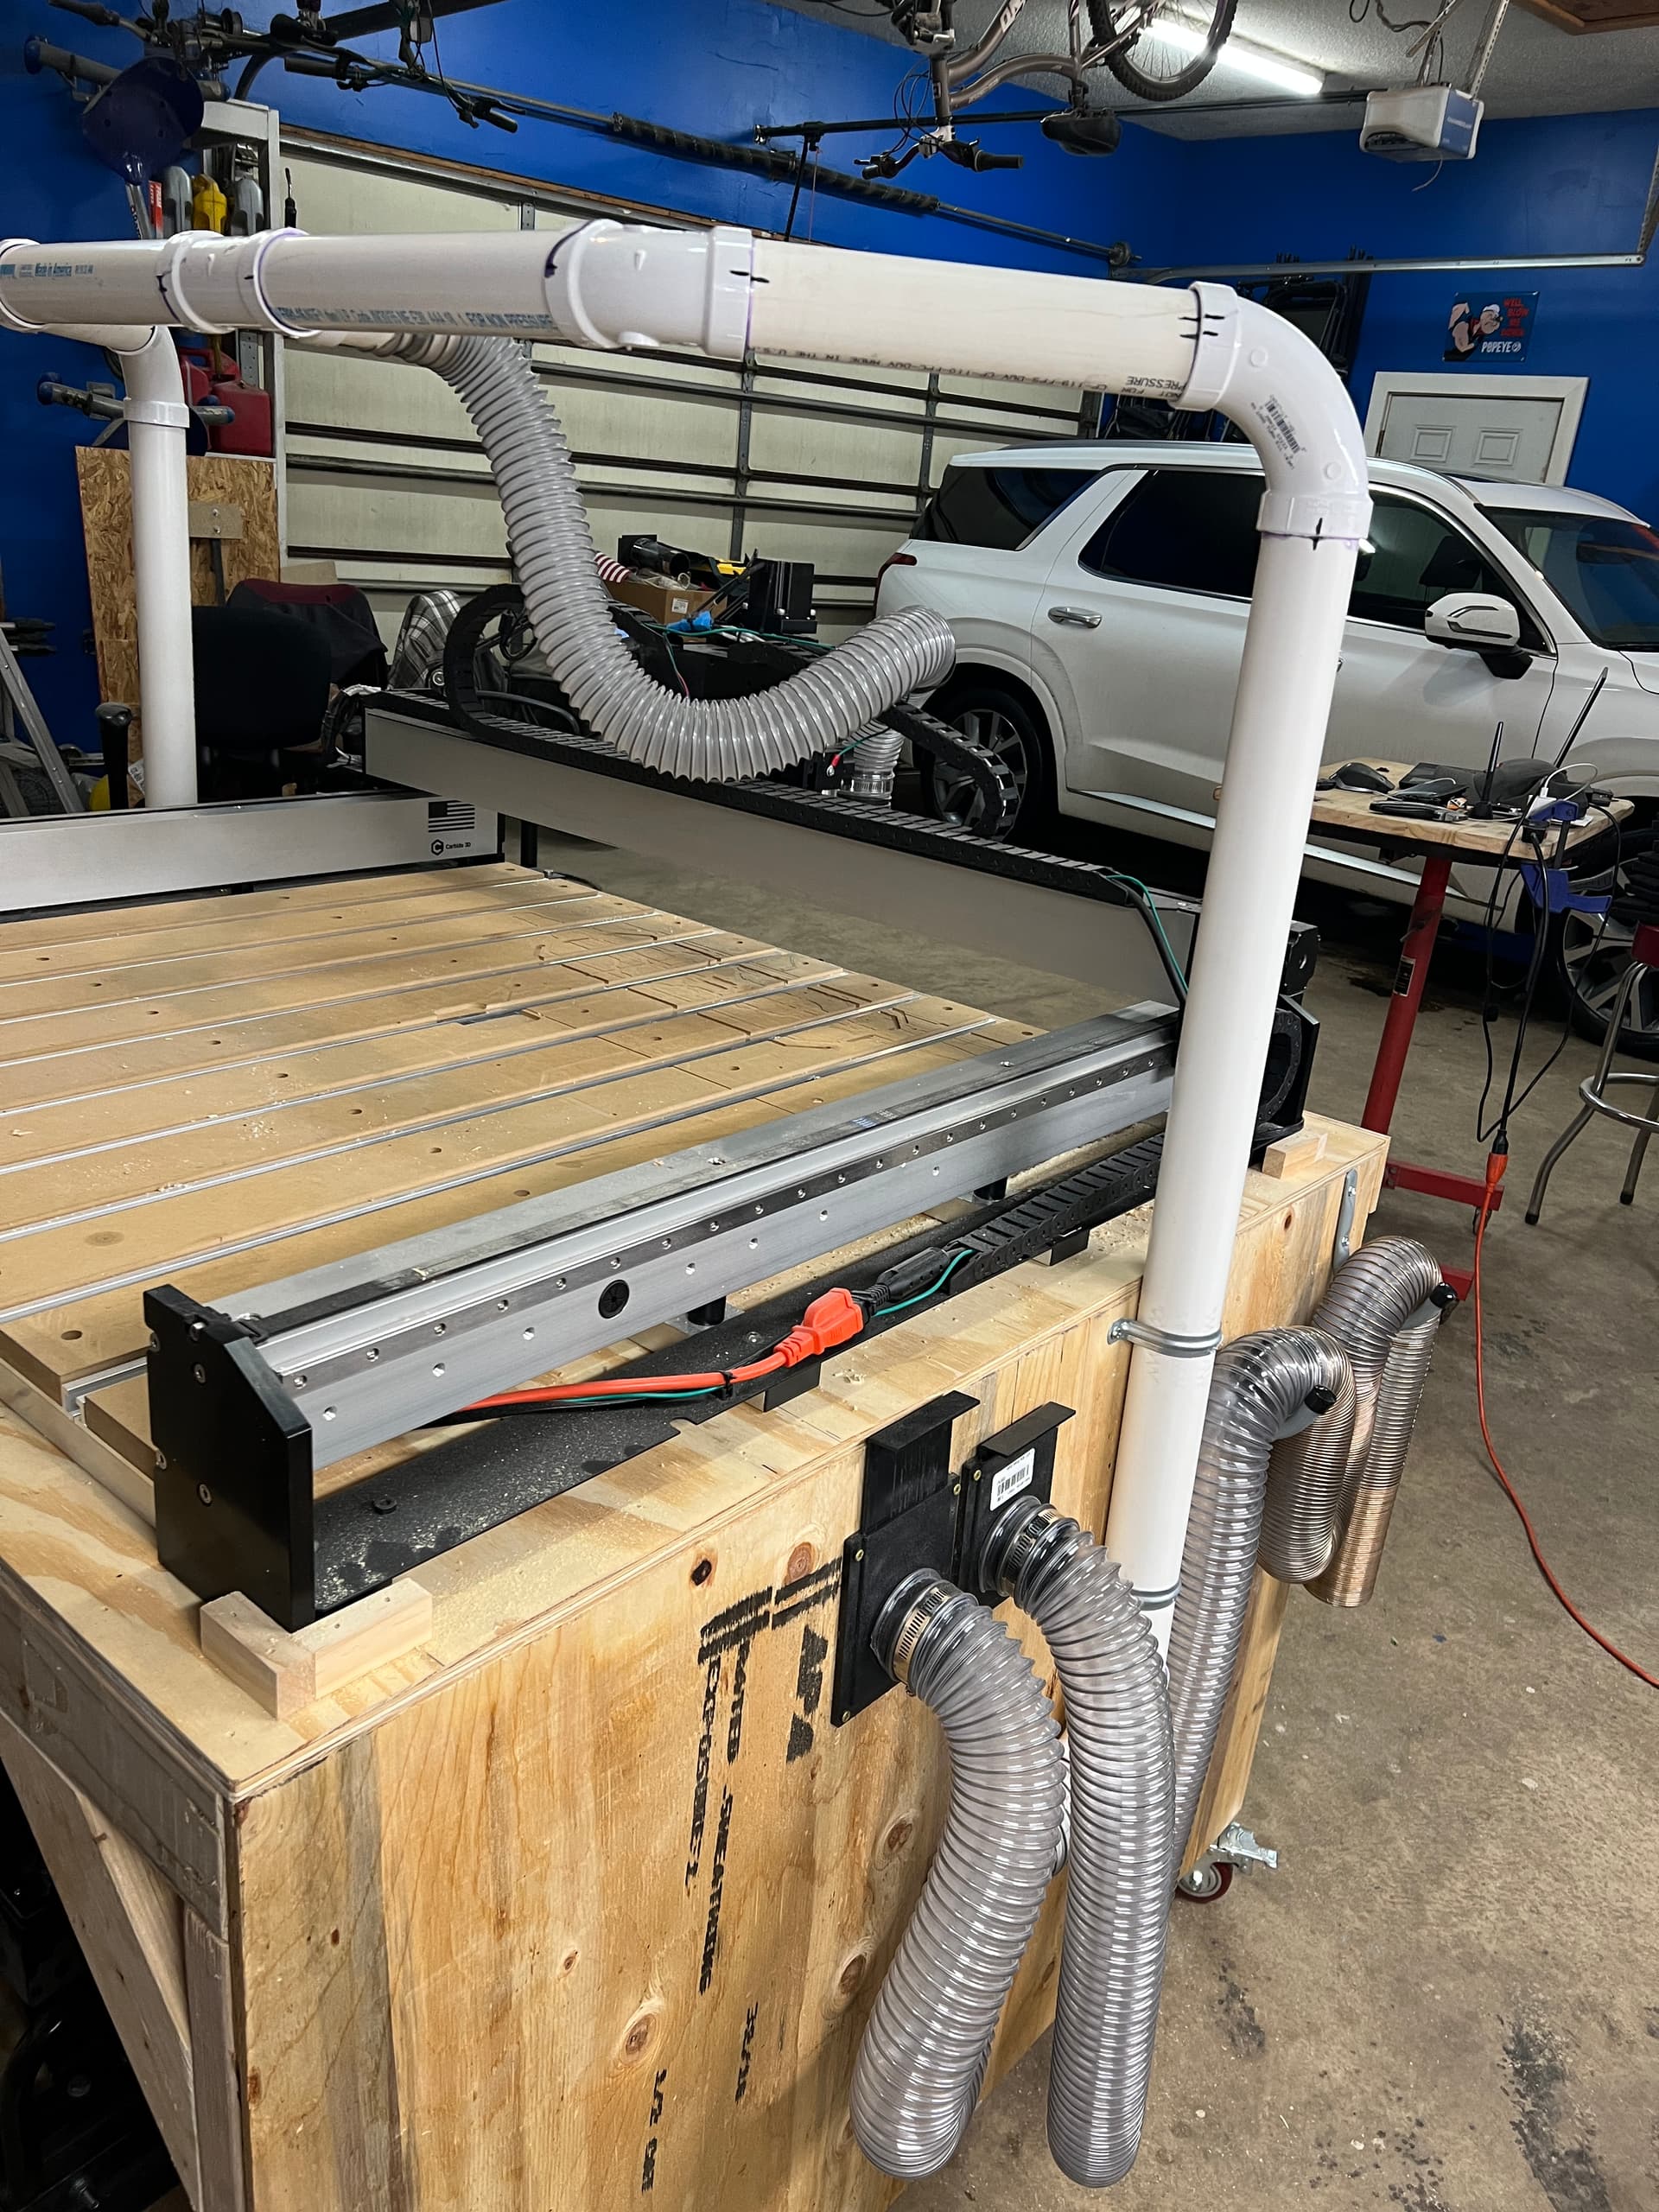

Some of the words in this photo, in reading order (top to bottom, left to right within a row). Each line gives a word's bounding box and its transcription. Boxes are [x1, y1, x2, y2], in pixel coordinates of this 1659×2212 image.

[1126, 376, 1187, 391] PRESSURE
[1481, 341, 1513, 353] POPEYE
[727, 1639, 751, 1764] RATED
[786, 1624, 829, 1764] APA
[699, 1784, 733, 1995] SHEATHING
